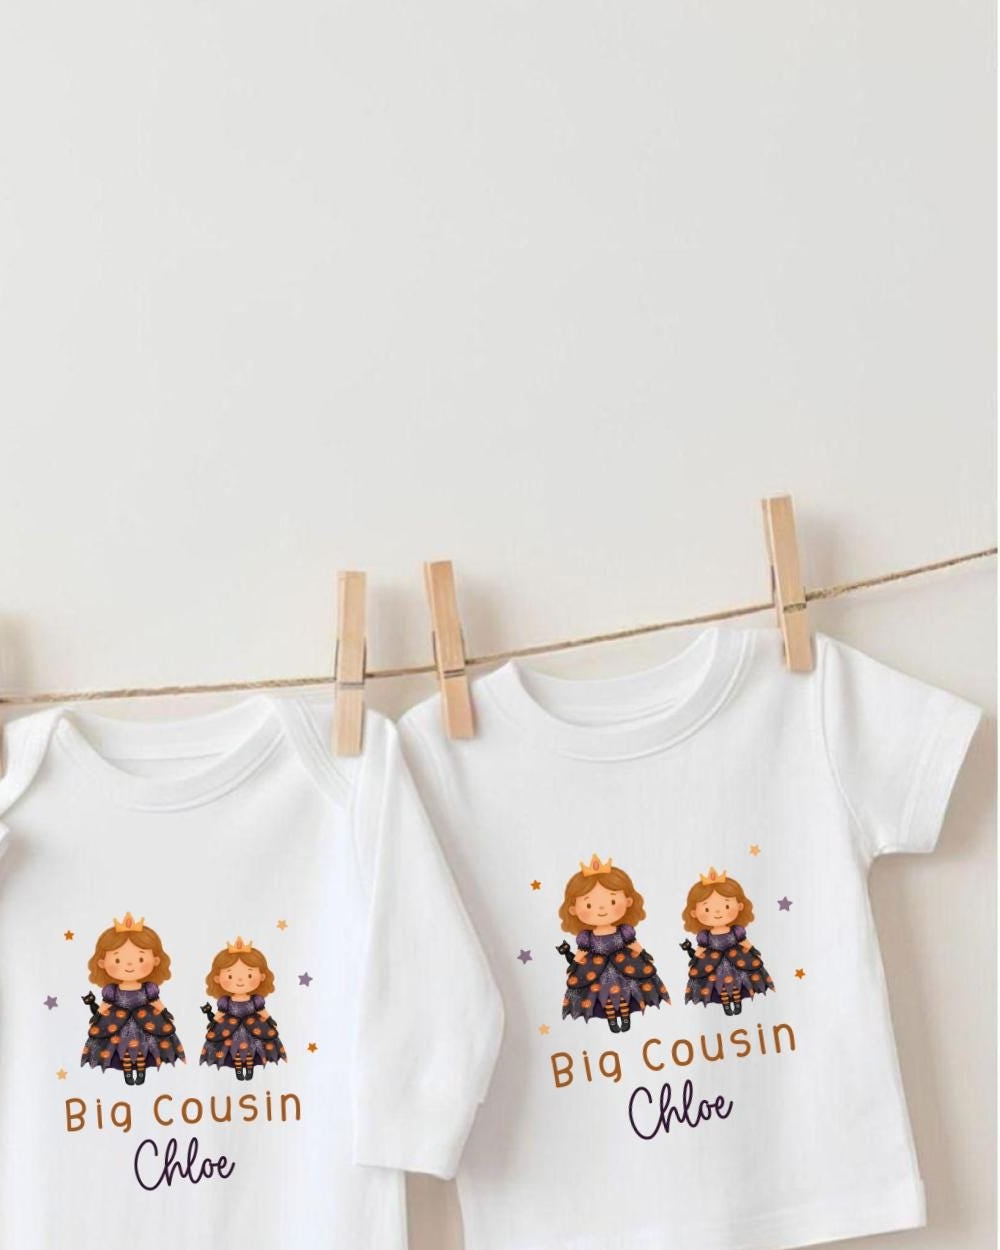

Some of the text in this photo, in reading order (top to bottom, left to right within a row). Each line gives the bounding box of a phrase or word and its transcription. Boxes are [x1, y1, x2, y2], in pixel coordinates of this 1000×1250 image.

[550, 1023, 797, 1089] Big Cousin
[64, 1090, 301, 1134] Big Cousin
[628, 1078, 734, 1141] Chloe
[133, 1136, 236, 1192] Chloe
